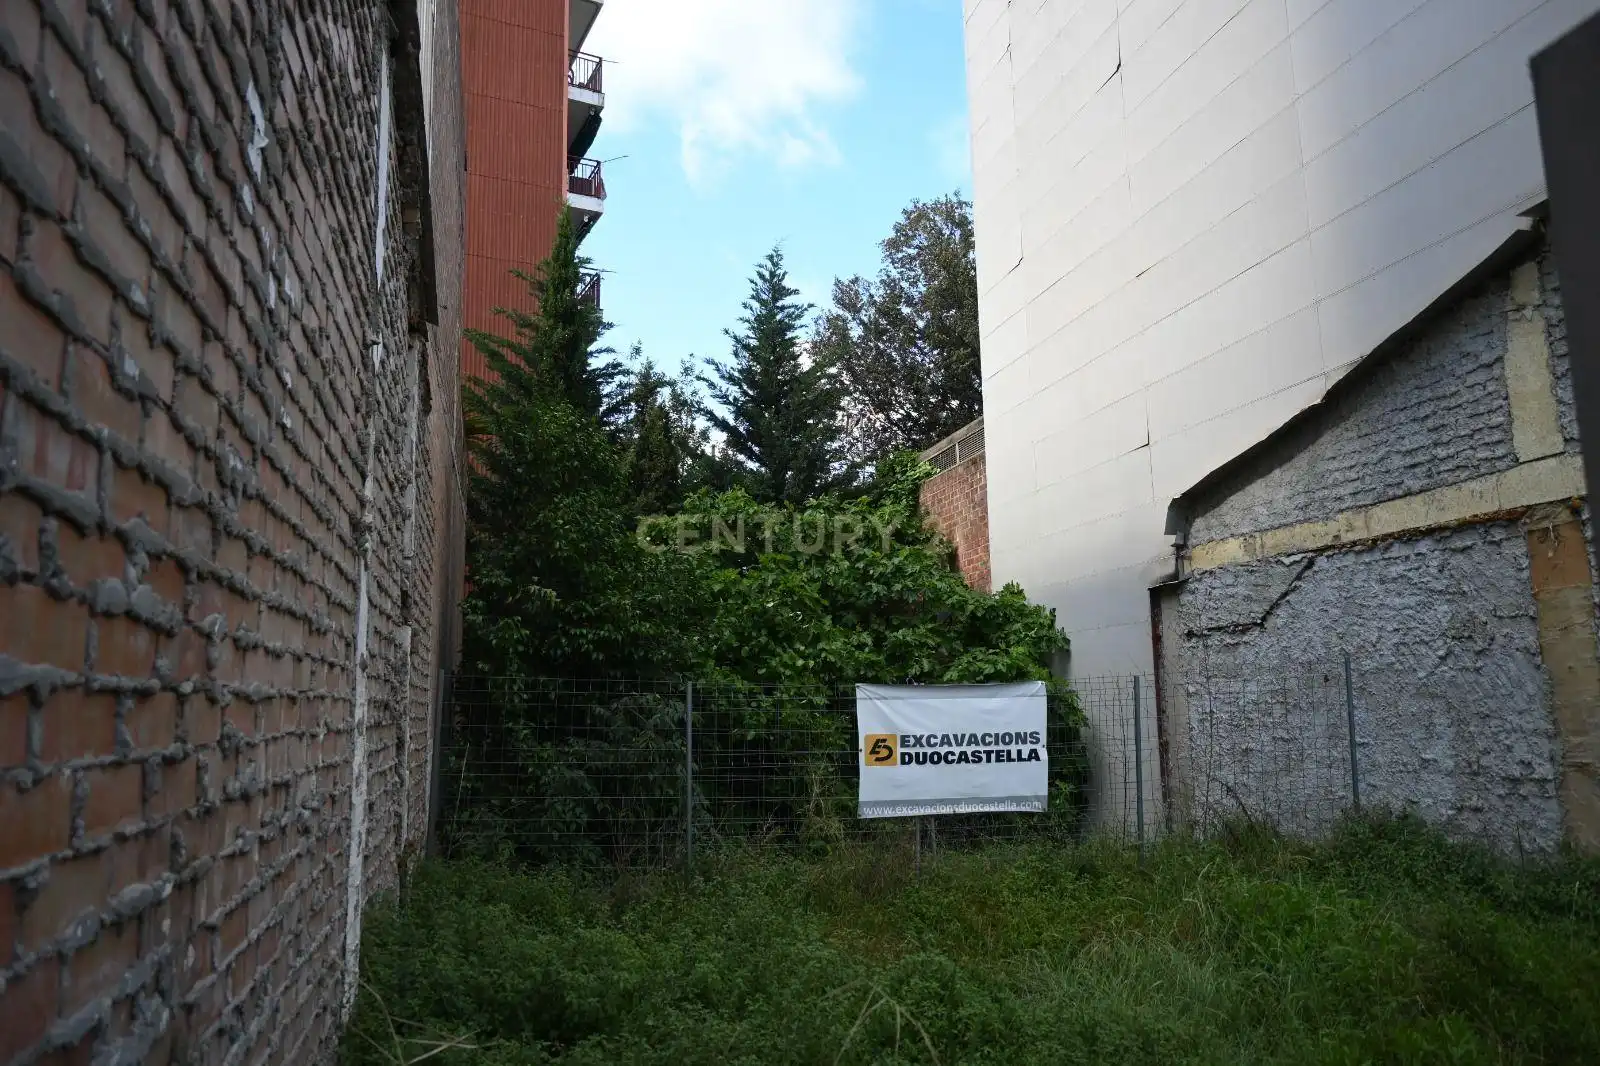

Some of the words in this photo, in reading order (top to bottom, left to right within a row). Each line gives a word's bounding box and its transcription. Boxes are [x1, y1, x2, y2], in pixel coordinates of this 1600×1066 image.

[900, 731, 1041, 748] EXCAVACIONS
[900, 748, 1041, 765] DUOCASTELLA
[863, 800, 1042, 815] www.excavacionsduocastella.com
